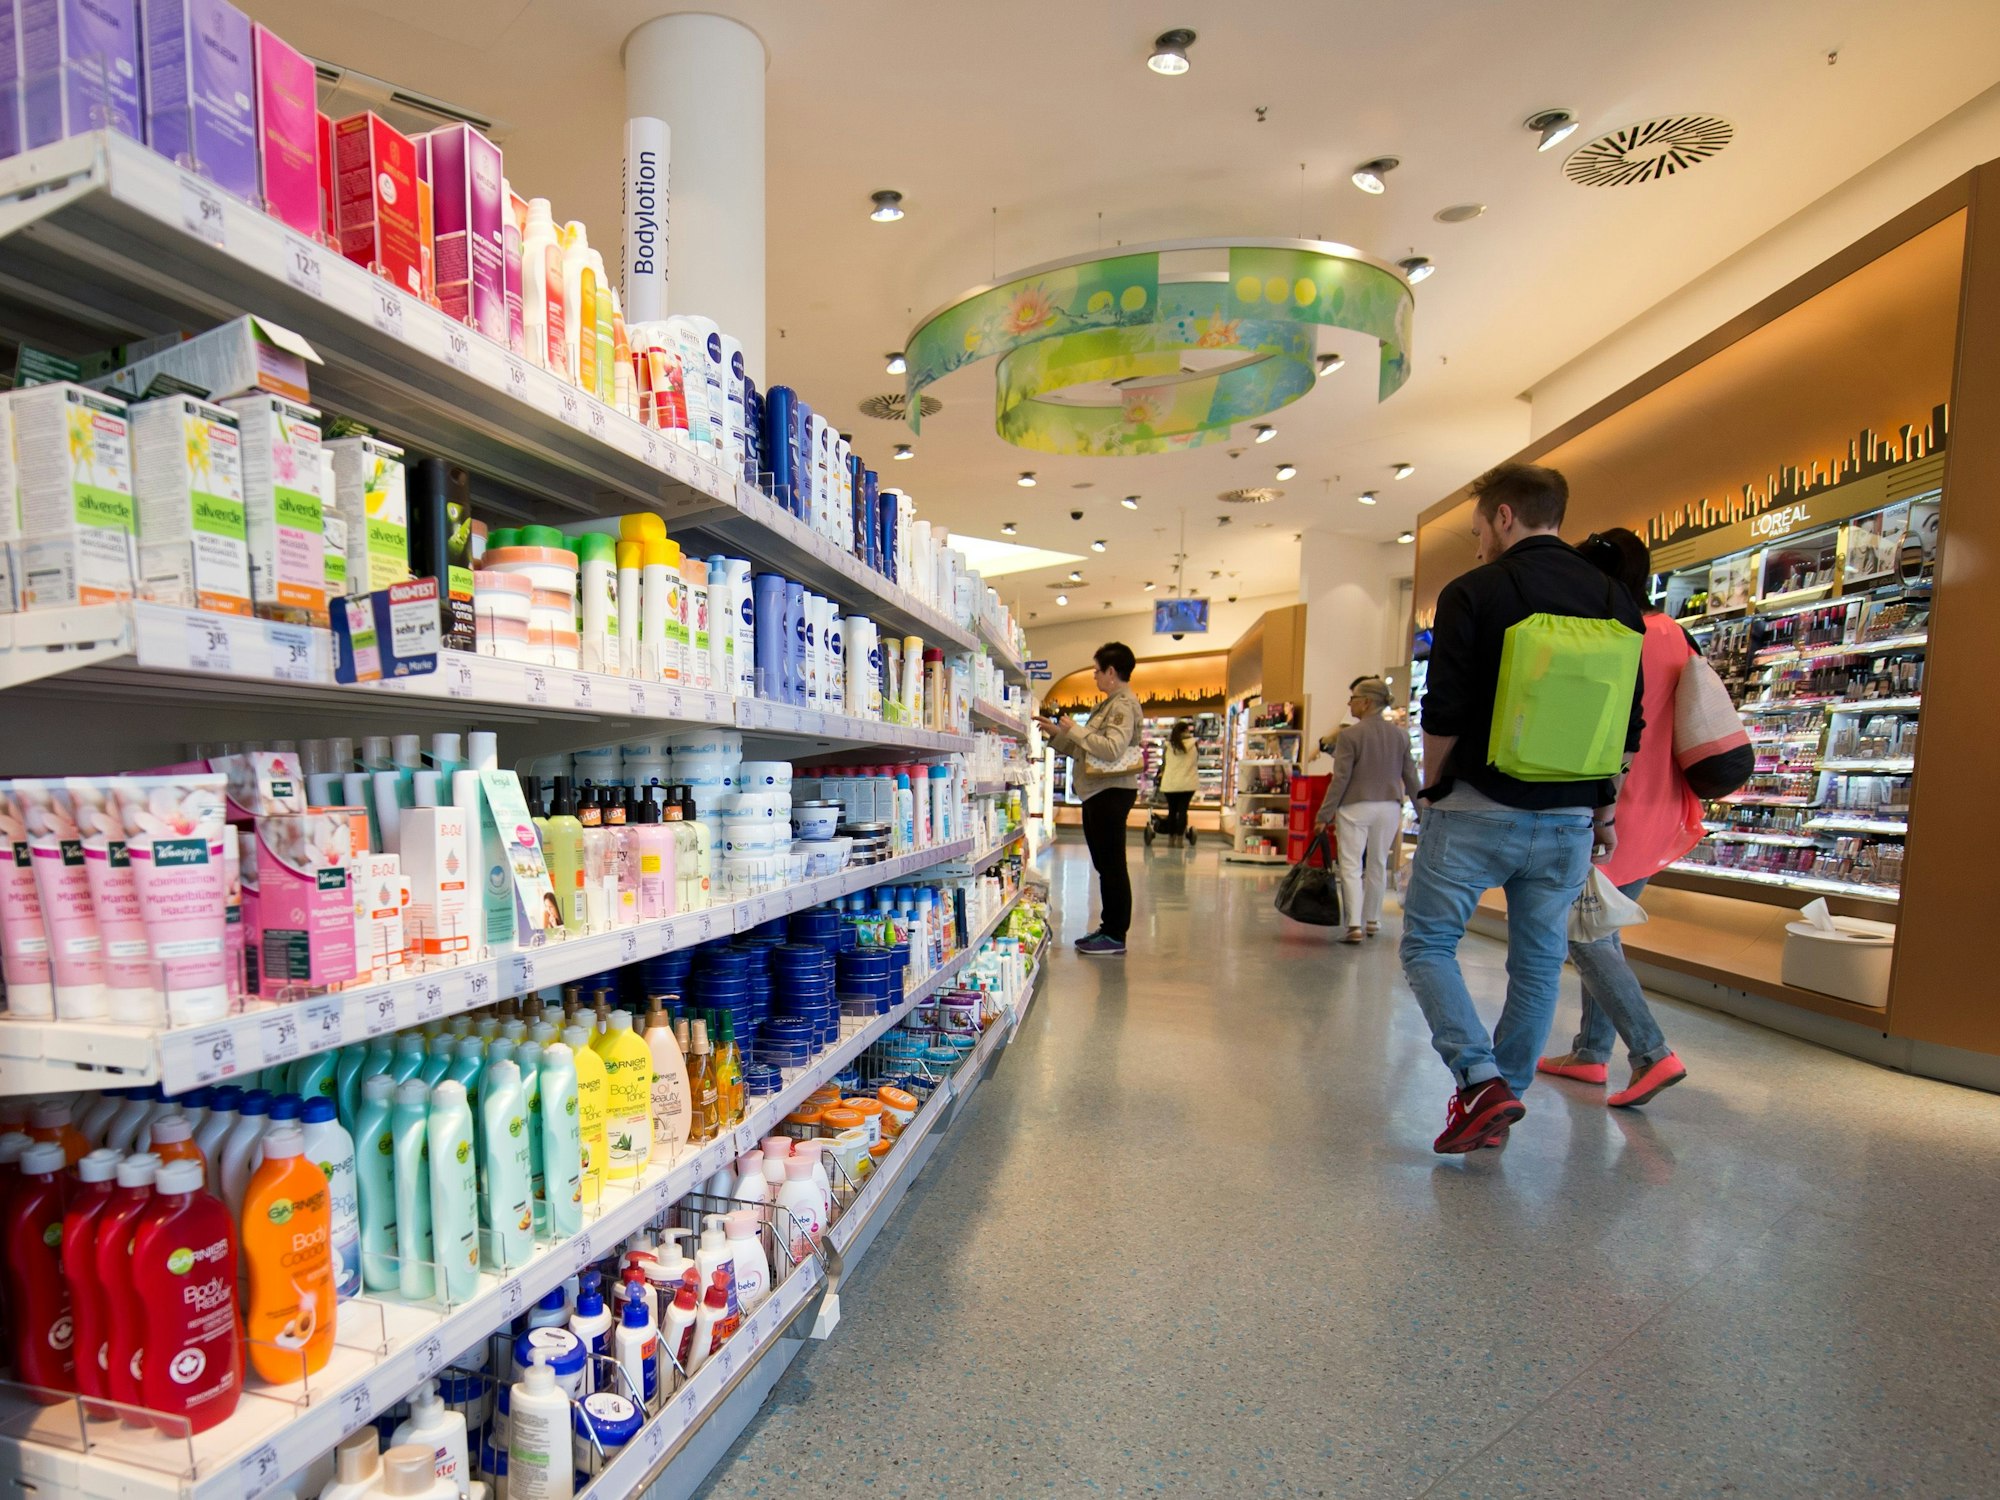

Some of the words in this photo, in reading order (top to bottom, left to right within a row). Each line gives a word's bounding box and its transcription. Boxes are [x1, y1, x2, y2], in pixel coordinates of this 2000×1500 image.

[634, 151, 659, 274] Bodylotion
[78, 494, 130, 519] alverde
[195, 501, 241, 525] alverde
[279, 496, 321, 519] alverde
[1751, 504, 1811, 537] L'ORÉAL
[370, 527, 405, 547] alverde
[1769, 525, 1790, 538] PARIS
[395, 622, 416, 635] sehr
[419, 620, 435, 636] gut
[409, 660, 433, 671] Marke
[155, 844, 206, 862] Kneipp
[605, 1057, 646, 1073] GARNIER
[579, 1080, 601, 1090] RNIER
[610, 1082, 640, 1097] Body
[657, 1083, 669, 1095] Oil
[627, 1091, 646, 1102] Tonic
[650, 1093, 679, 1103] Beauty
[291, 1224, 328, 1252] Body
[168, 1239, 228, 1271] GARNIER
[183, 1276, 224, 1305] Body
[738, 1280, 756, 1290] bebe
[195, 1286, 233, 1313] Repair
